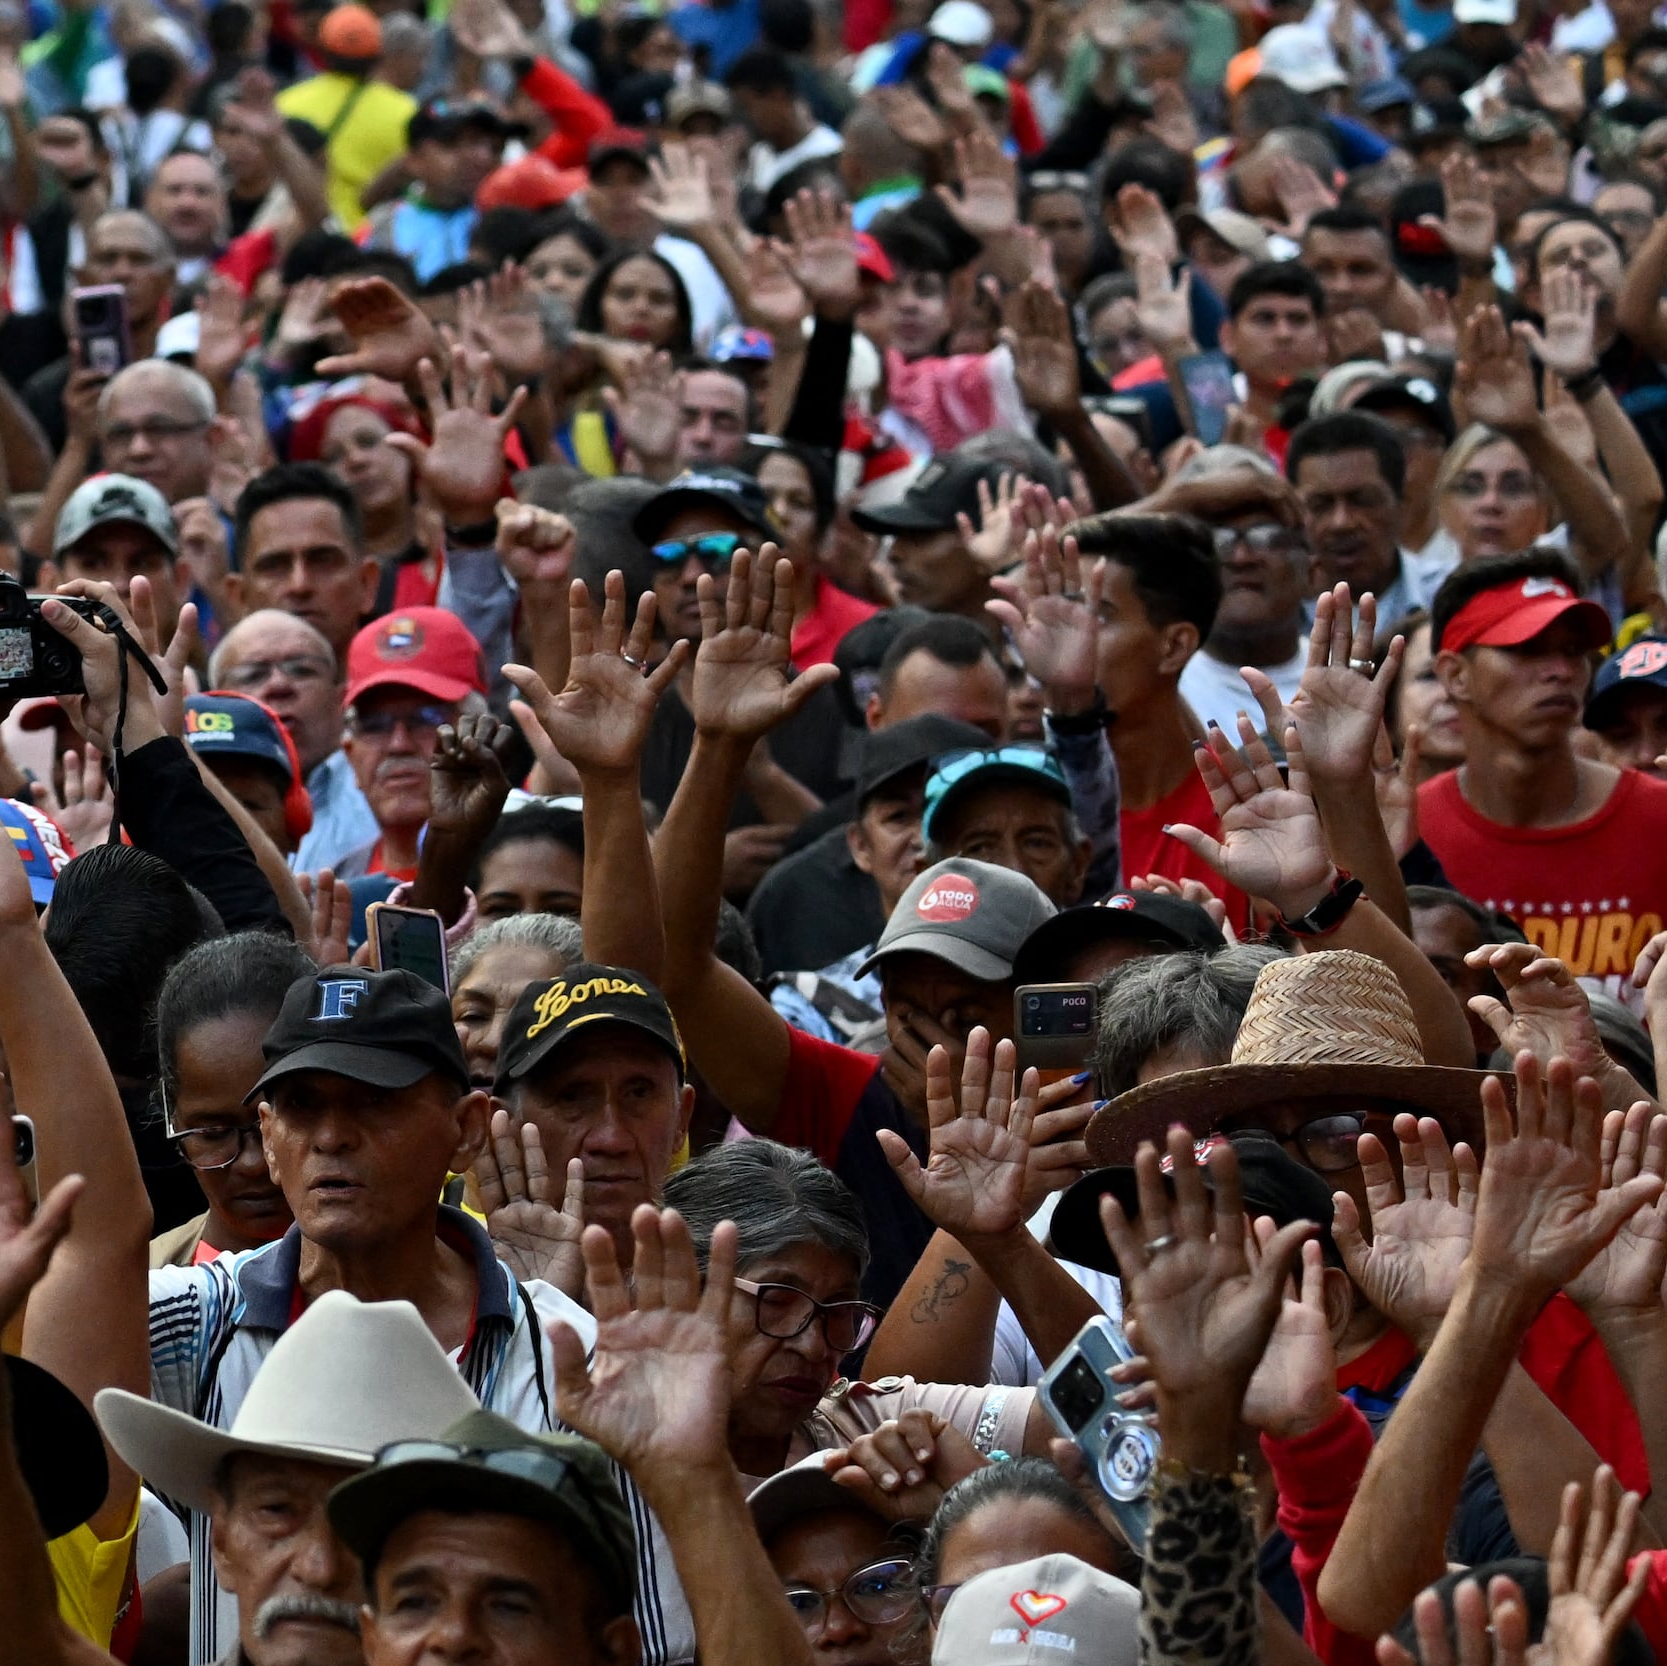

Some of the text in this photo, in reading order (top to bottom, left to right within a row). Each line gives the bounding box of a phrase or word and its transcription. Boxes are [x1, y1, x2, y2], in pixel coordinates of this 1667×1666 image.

[938, 889, 975, 903] TODO
[306, 979, 370, 1022] F
[527, 977, 649, 1041] Leones
[1062, 997, 1087, 1007] POCO
